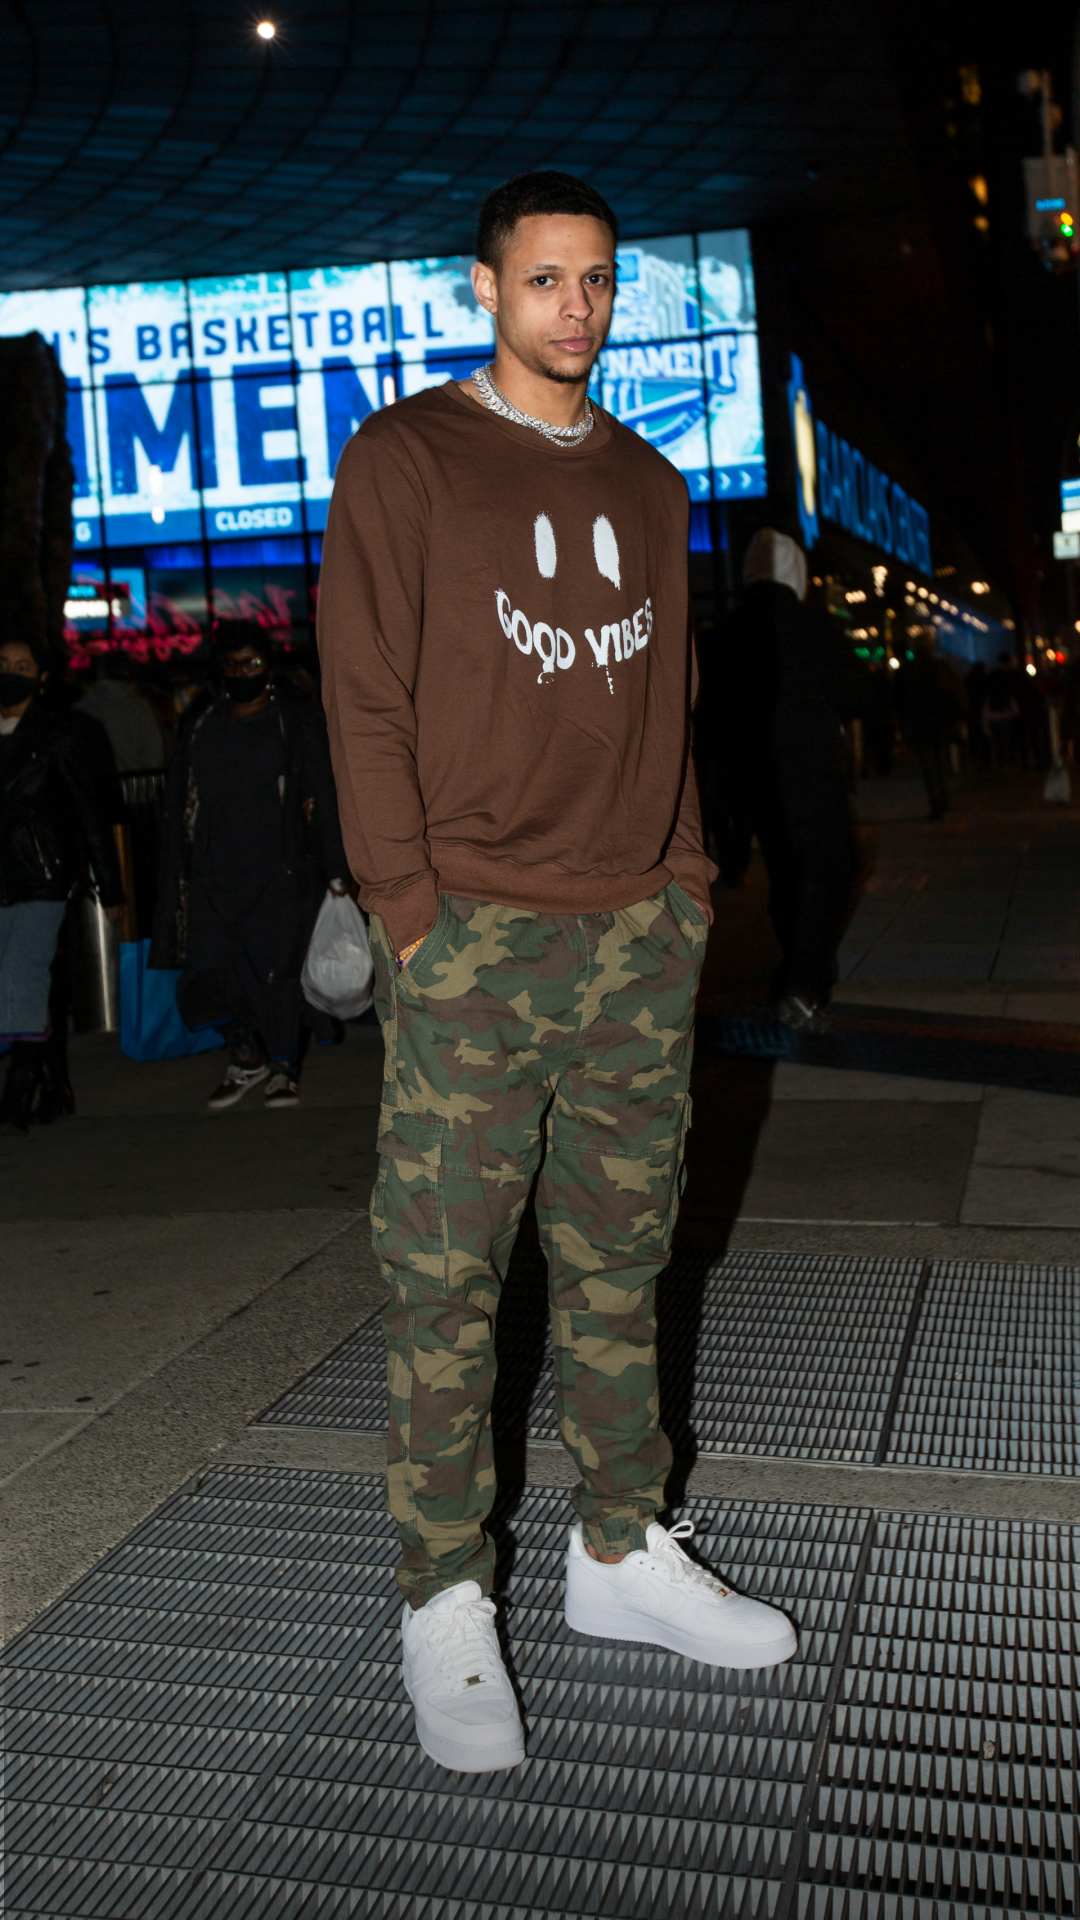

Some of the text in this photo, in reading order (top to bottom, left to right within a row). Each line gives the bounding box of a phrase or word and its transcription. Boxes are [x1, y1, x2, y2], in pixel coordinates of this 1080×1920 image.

[136, 302, 443, 362] BASKETBALL
[214, 506, 293, 532] CLOSED
[494, 588, 653, 673] GOOD VIBES
